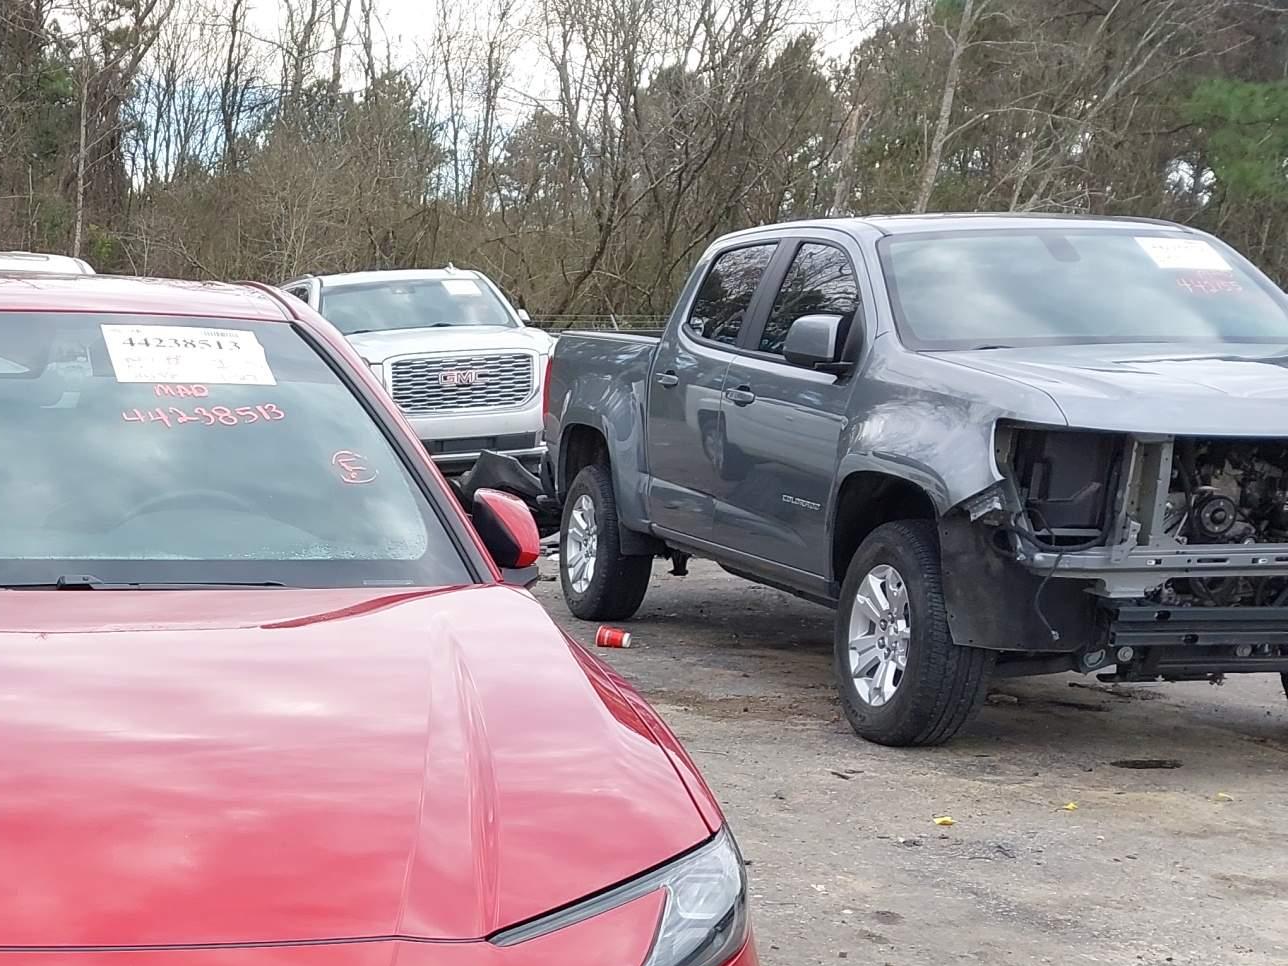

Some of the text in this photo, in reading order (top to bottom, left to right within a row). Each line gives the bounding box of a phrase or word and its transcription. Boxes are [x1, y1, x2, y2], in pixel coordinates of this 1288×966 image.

[122, 336, 241, 352] 44238513
[438, 369, 490, 385] GMC
[153, 383, 209, 398] MAD
[121, 403, 285, 428] 44238513
